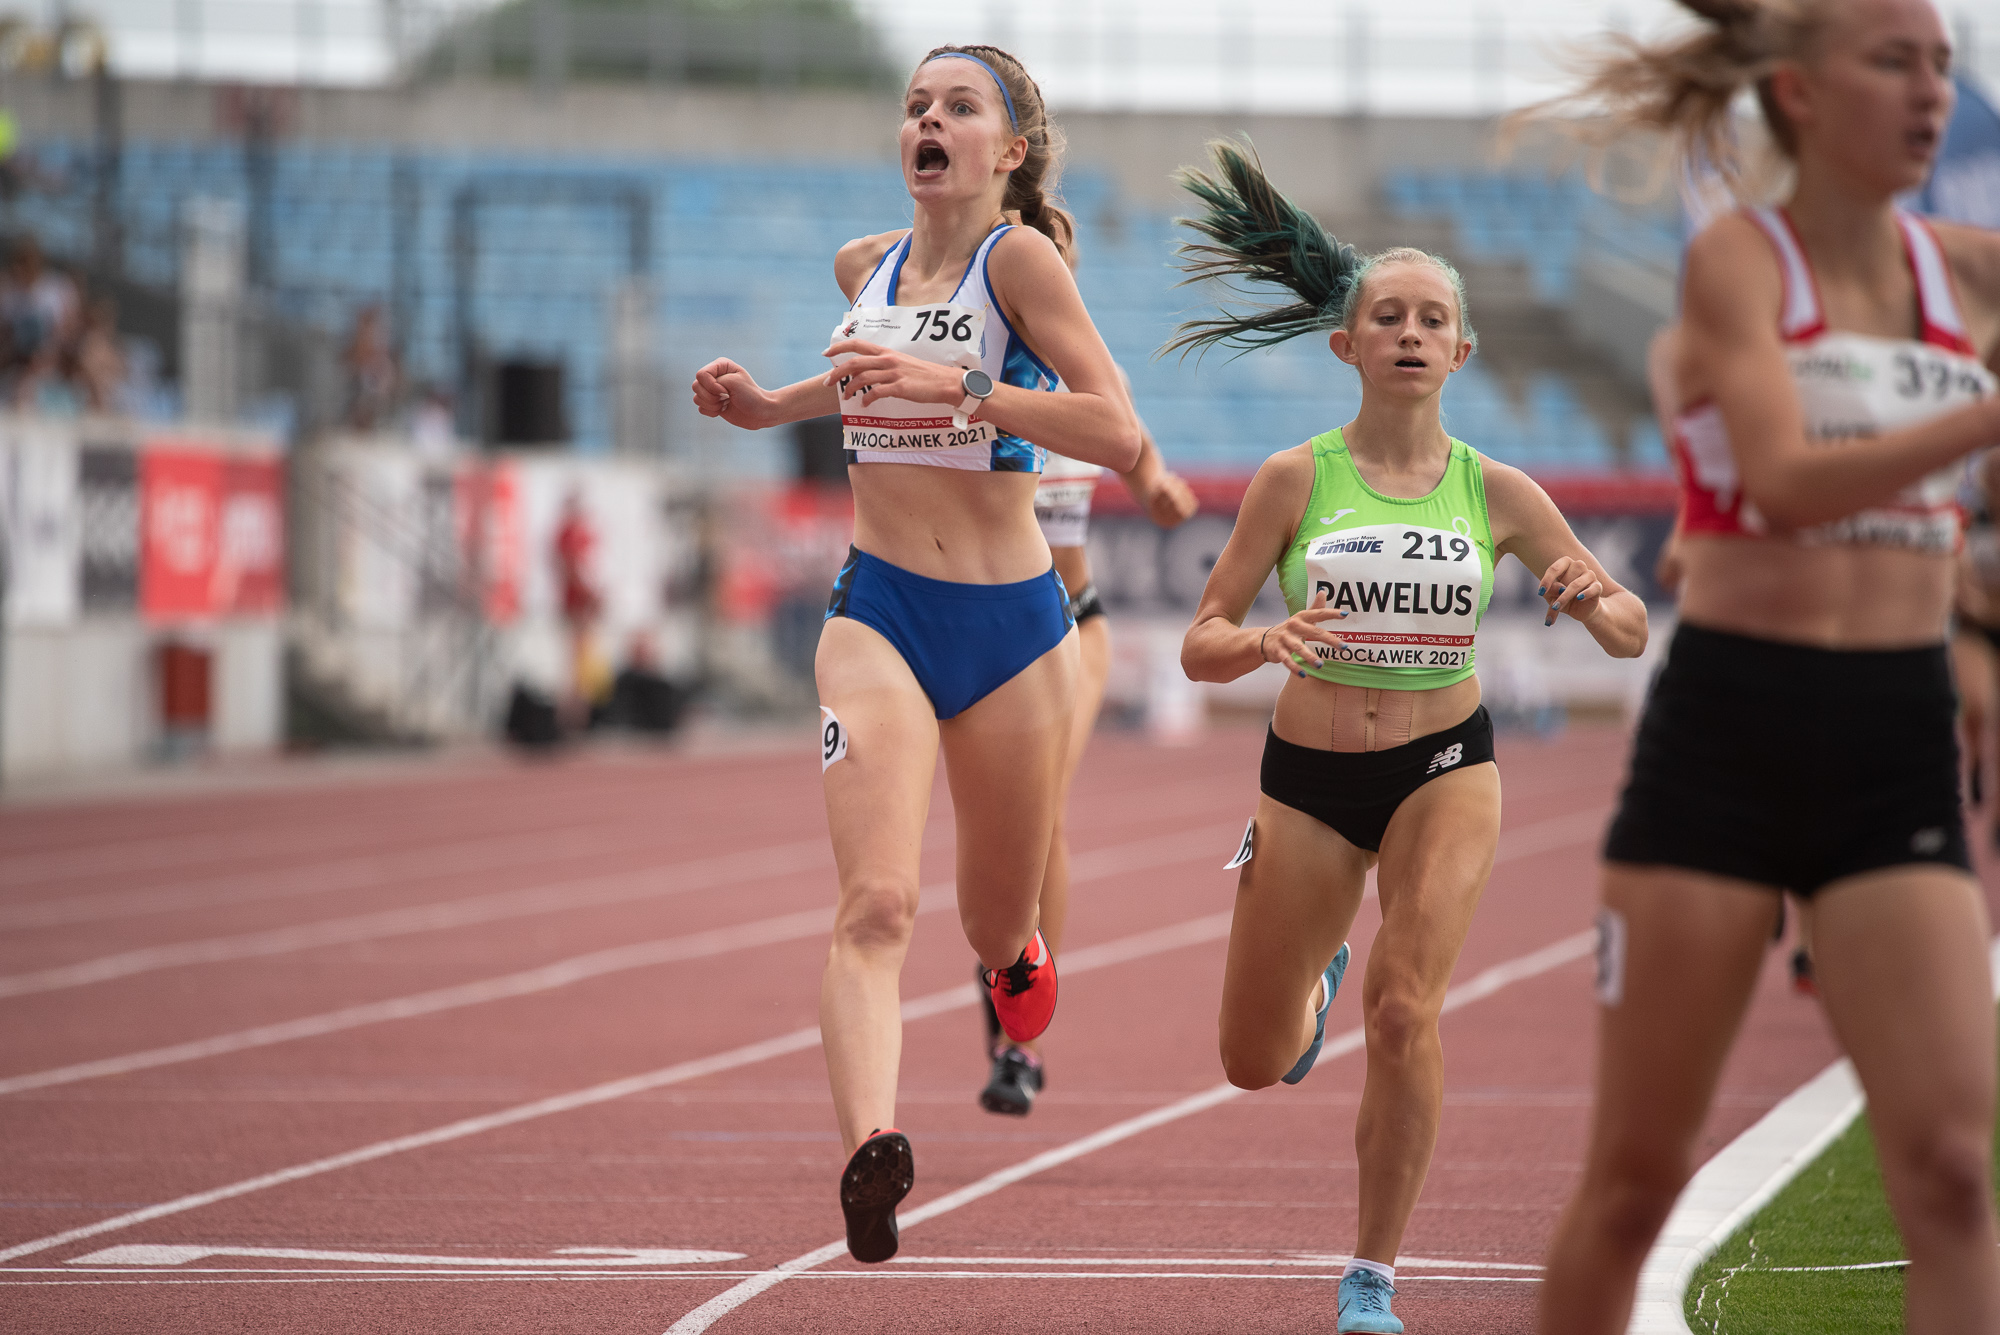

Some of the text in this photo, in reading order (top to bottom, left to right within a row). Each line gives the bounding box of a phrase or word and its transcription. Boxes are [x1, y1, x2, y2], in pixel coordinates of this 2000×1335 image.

[910, 309, 974, 342] 756
[860, 418, 879, 426] PZLA
[879, 420, 935, 428] MISTRZOSTWA
[850, 426, 987, 449] WŁOCŁAWEK 2021
[1401, 530, 1470, 562] 219
[1315, 580, 1473, 617] PAWELUS
[1355, 634, 1419, 643] MISTRZOSTWA
[1420, 637, 1453, 645] POLSKI
[1314, 646, 1466, 666] WŁOCŁAWEK 2021
